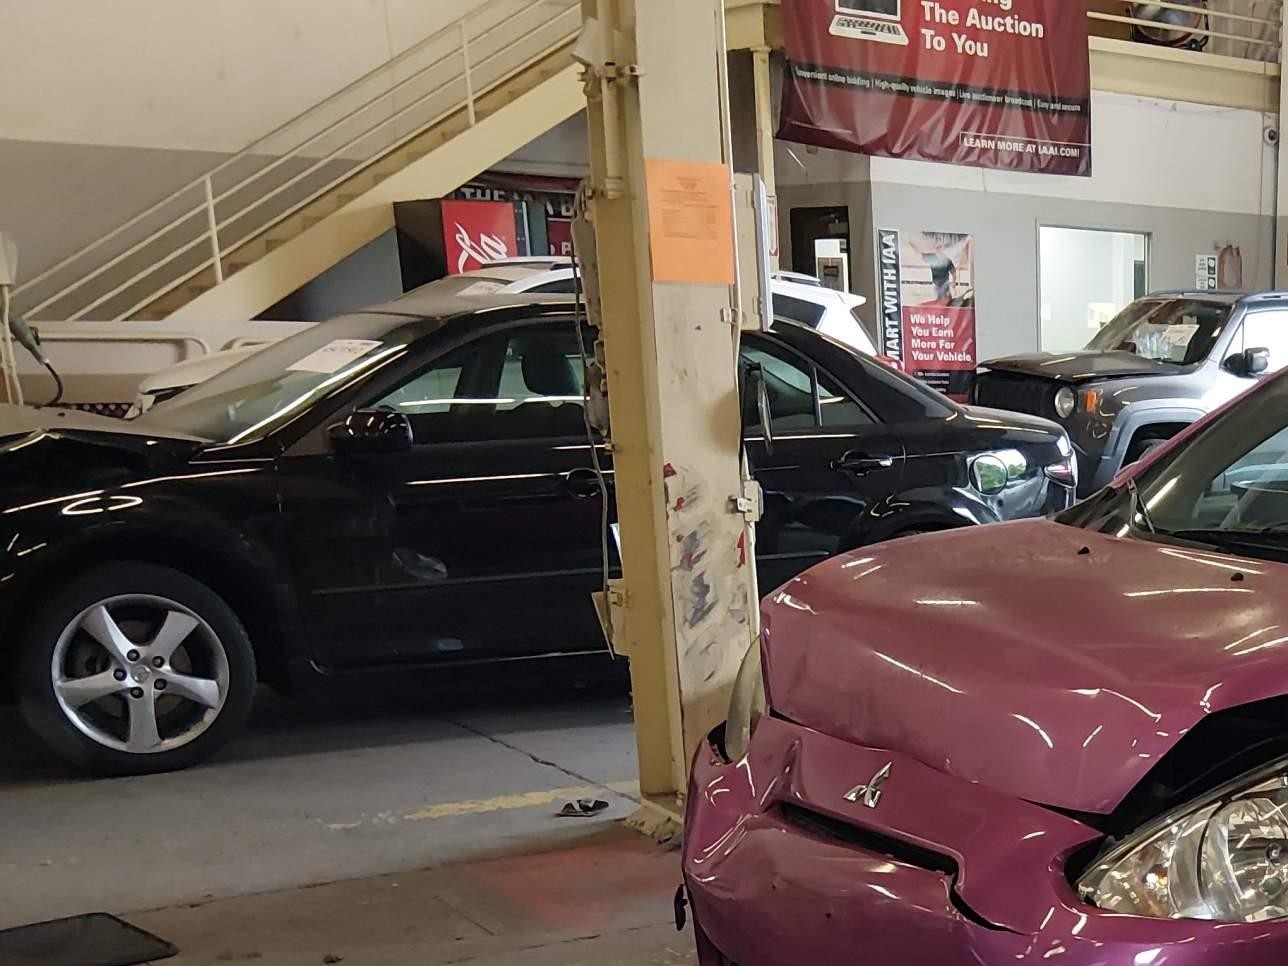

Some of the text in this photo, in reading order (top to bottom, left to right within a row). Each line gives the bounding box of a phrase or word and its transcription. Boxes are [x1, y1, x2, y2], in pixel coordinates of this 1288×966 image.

[920, 1, 1044, 38] The Auction
[921, 29, 989, 57] To You
[963, 137, 995, 150] LEARN
[997, 141, 1025, 152] MORE
[1026, 144, 1037, 153] AT
[882, 234, 896, 265] IAA
[883, 269, 898, 314] WITH
[910, 314, 950, 327] We Help
[911, 327, 954, 337] You Earn
[911, 339, 955, 349] More For
[912, 351, 935, 361] Your
